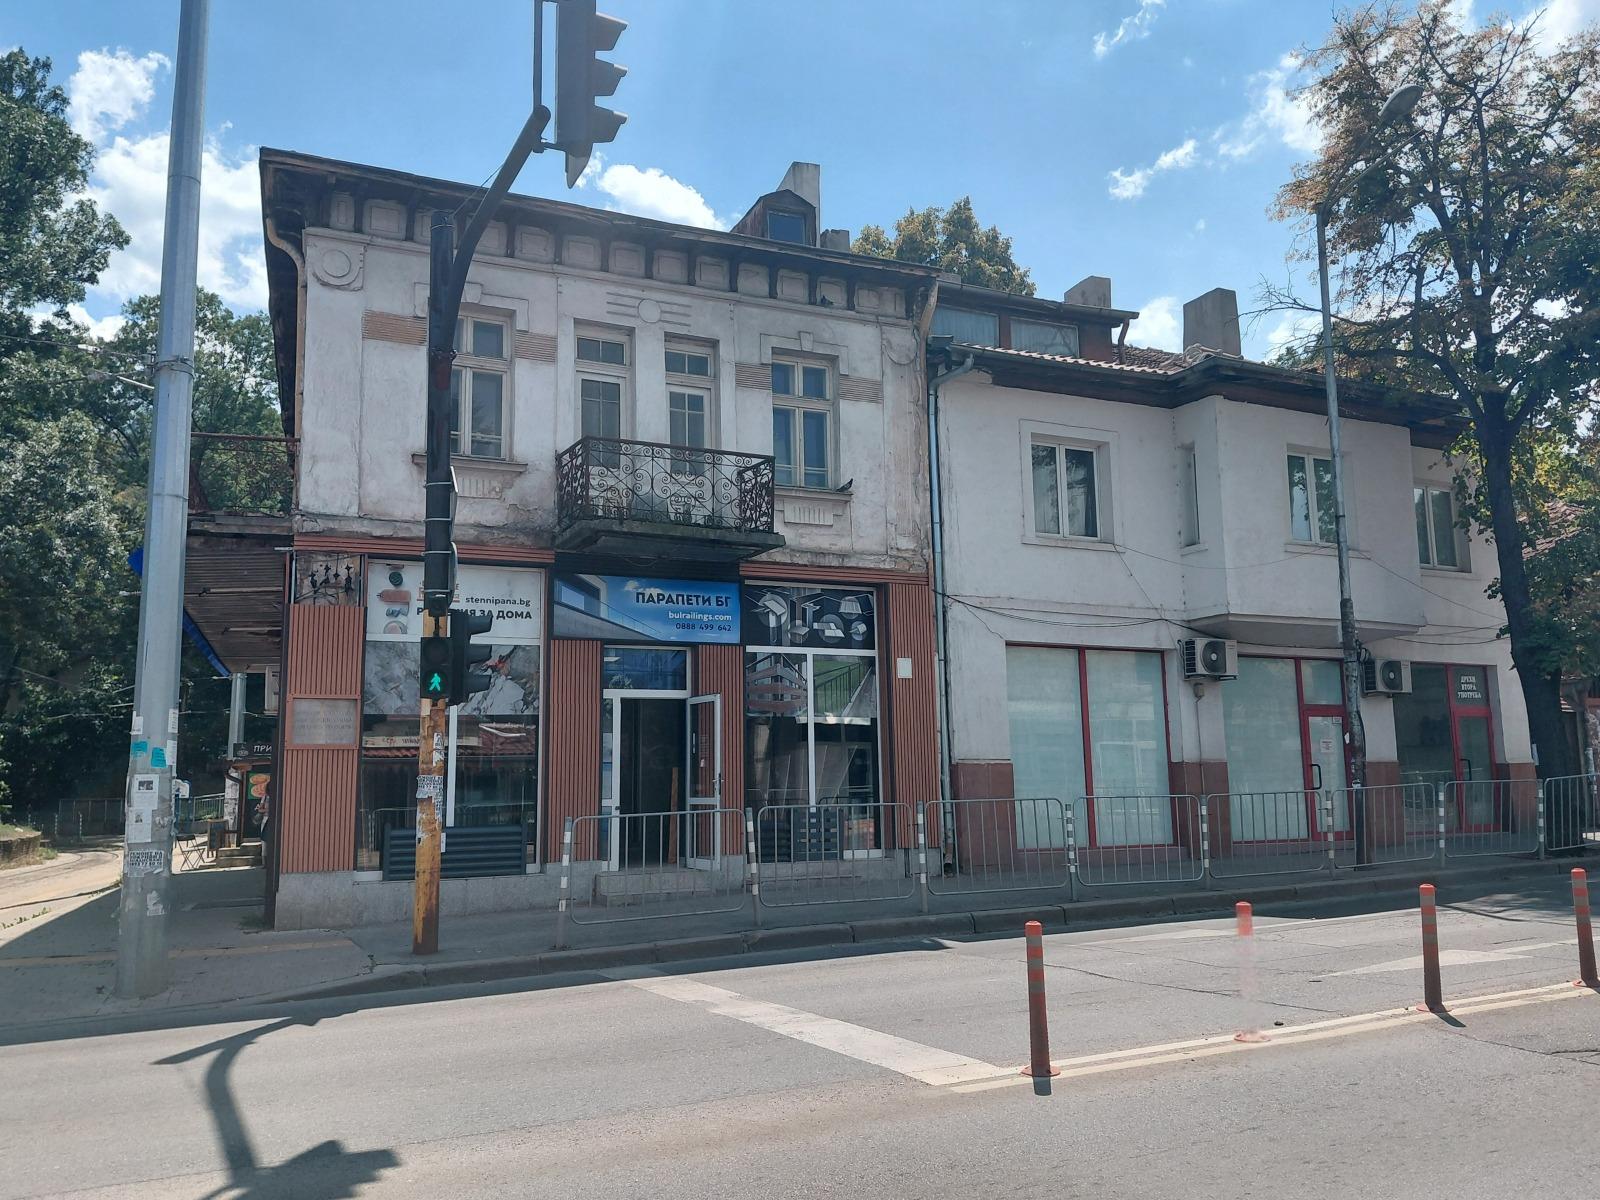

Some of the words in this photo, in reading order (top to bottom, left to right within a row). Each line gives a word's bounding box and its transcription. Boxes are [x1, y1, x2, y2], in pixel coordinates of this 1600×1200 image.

[465, 597, 531, 607] stennipana.bg
[635, 592, 711, 606] ПАРАПЕТИ
[716, 596, 732, 607] БГ
[496, 610, 532, 620] ДОМА
[668, 611, 732, 621] bulrailings.com
[675, 622, 696, 630] 0888
[699, 623, 714, 631] 499
[717, 624, 732, 632] 642
